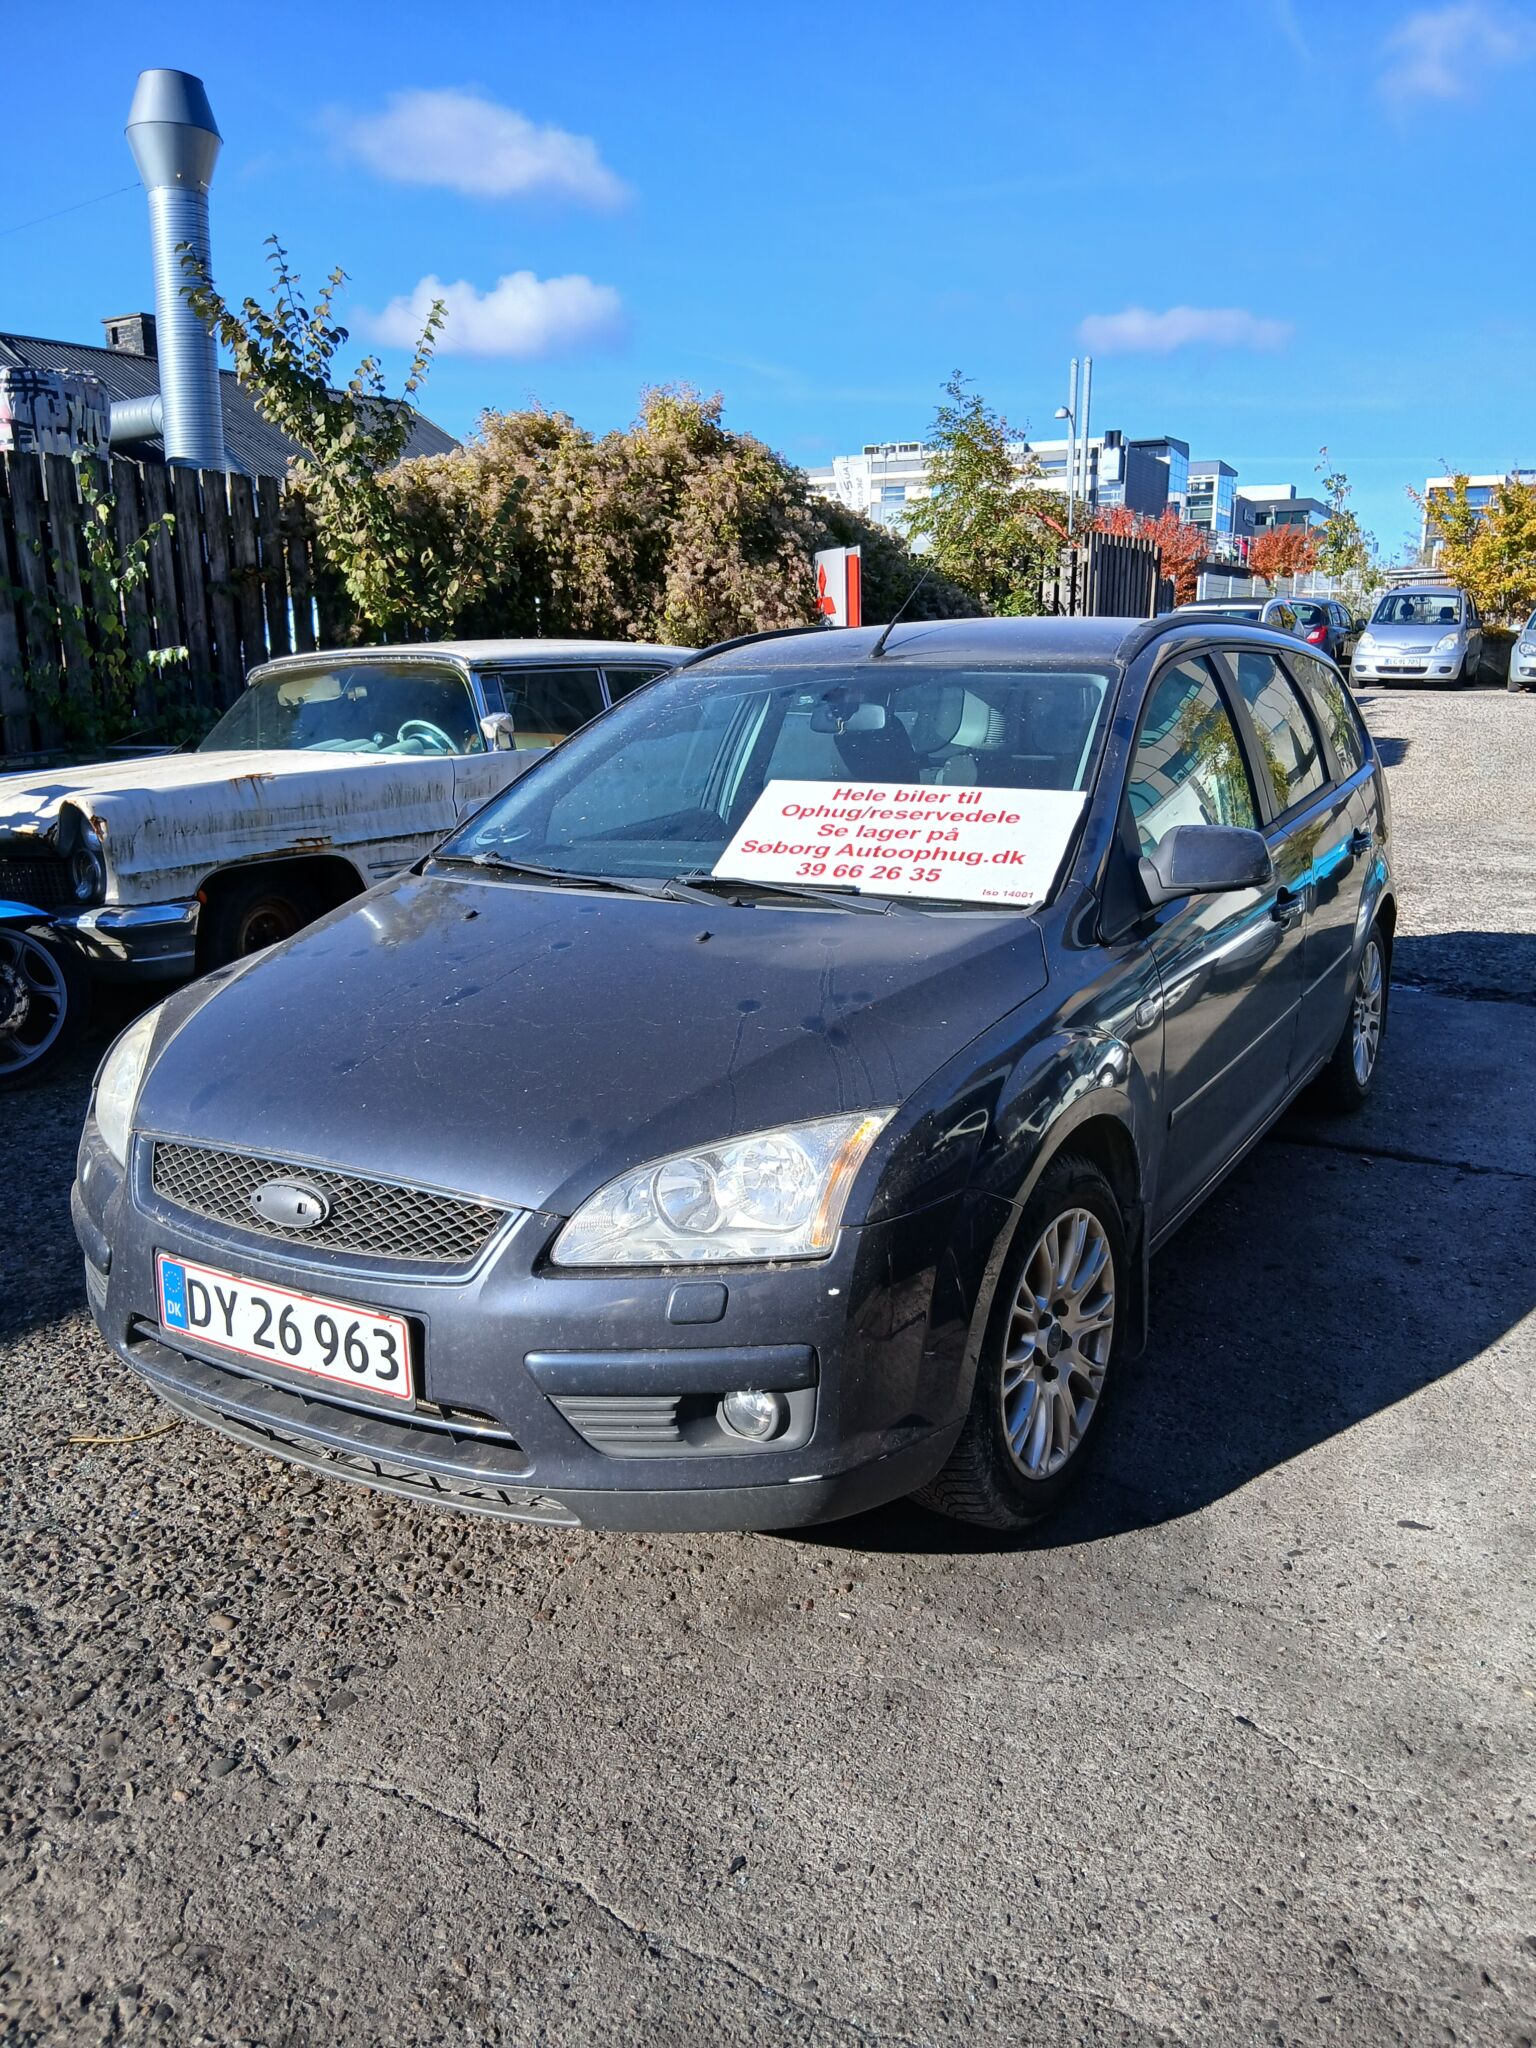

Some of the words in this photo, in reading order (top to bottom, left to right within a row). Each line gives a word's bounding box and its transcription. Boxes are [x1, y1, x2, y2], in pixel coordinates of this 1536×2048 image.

[832, 788, 886, 802] Hele
[894, 790, 951, 804] biler
[957, 791, 983, 805] til
[781, 804, 1021, 824] Ophug/reservedele
[816, 823, 849, 838] Se
[856, 825, 921, 842] lager
[926, 827, 960, 844] på
[740, 840, 831, 859] Søborg
[835, 843, 1026, 866] Autoophug.dk
[796, 862, 827, 878] 39
[832, 863, 865, 879] 66
[869, 865, 902, 882] 26
[908, 867, 942, 883] 35
[1003, 890, 1034, 898] 14001
[167, 1299, 182, 1318] DK
[187, 1277, 238, 1337] DY
[251, 1296, 303, 1356] 26
[314, 1313, 400, 1382] 963
